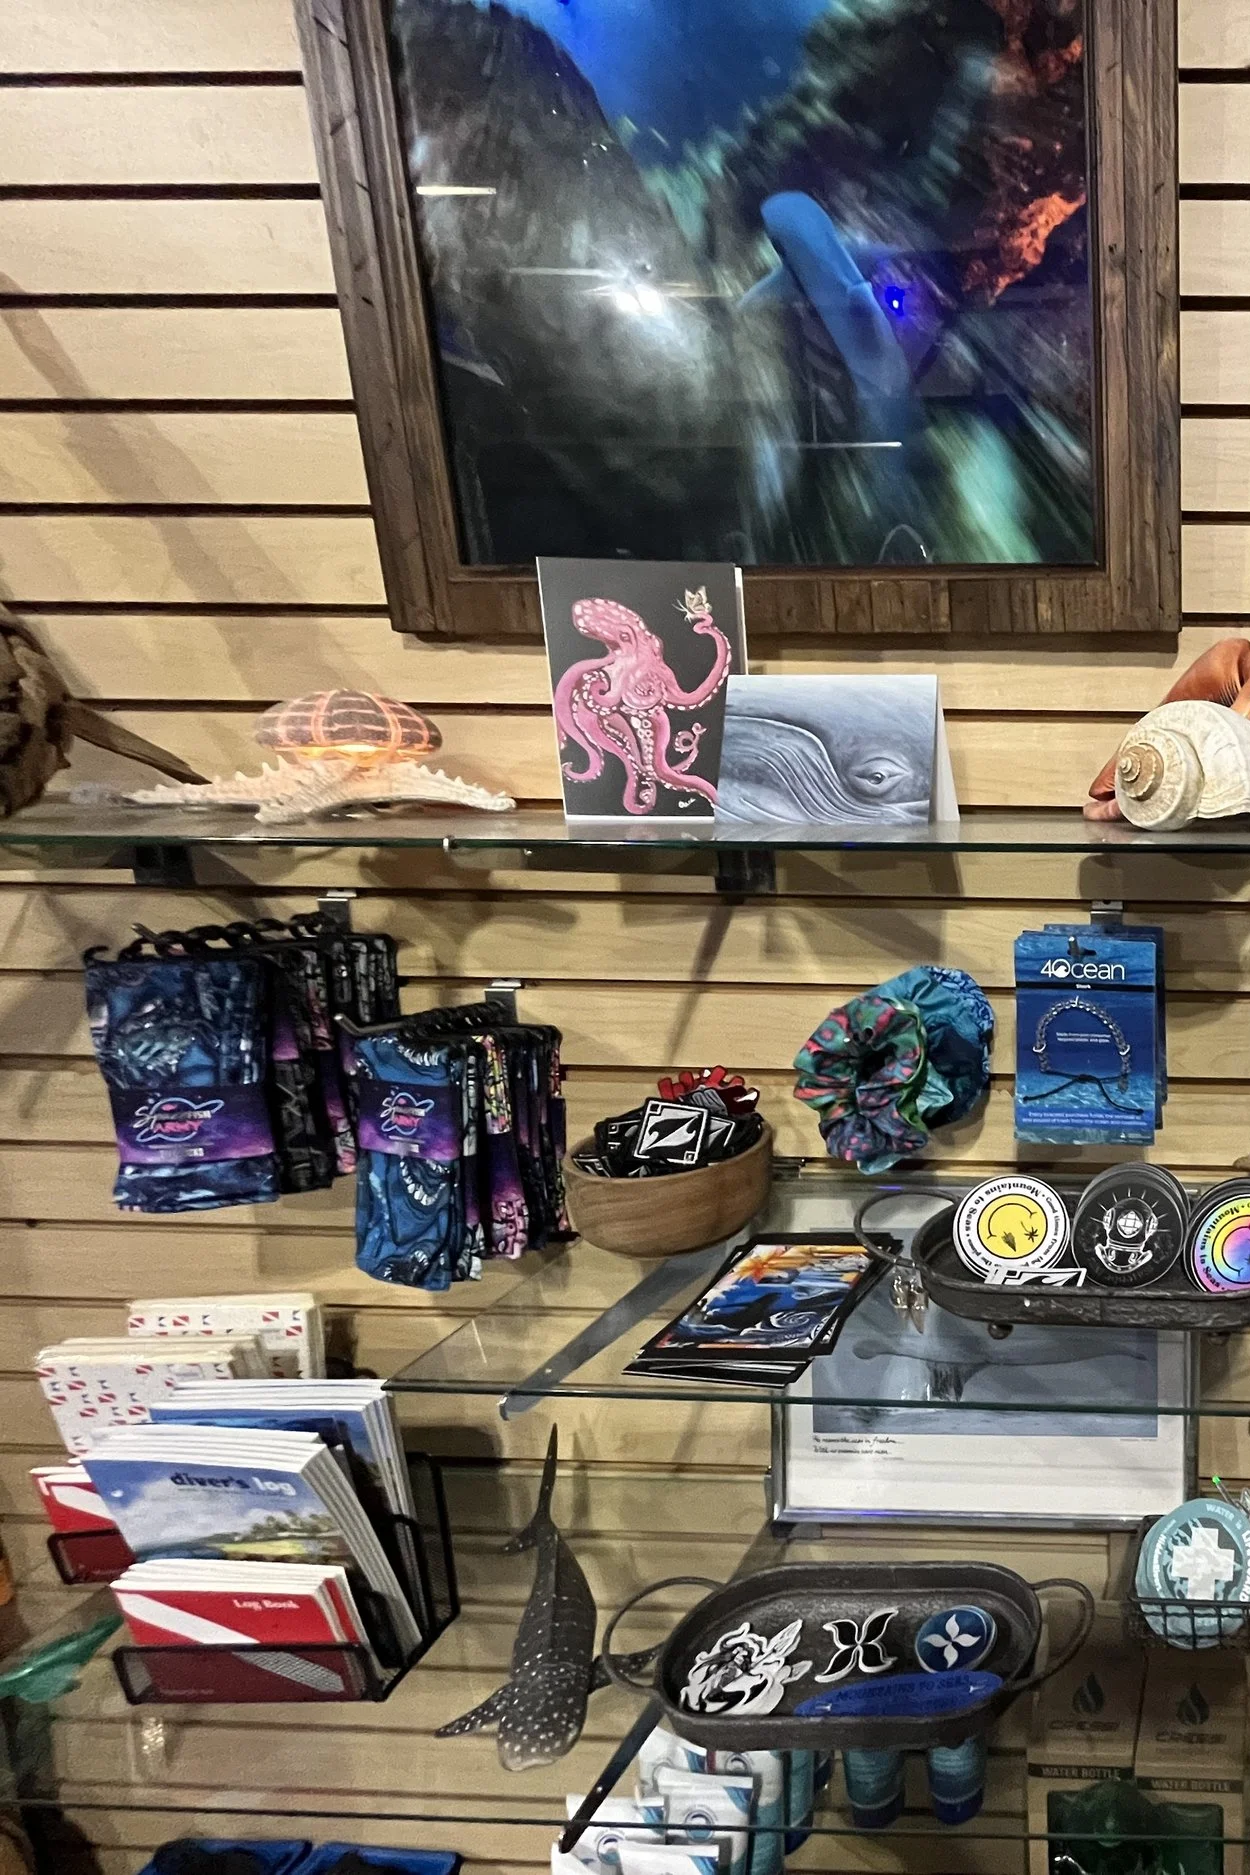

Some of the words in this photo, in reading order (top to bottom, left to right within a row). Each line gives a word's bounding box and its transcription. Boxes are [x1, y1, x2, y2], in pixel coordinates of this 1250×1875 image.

[985, 1182, 1041, 1197] Mountains
[974, 1196, 985, 1205] to
[1045, 1196, 1058, 1214] Good
[965, 1207, 978, 1232] Seas
[1200, 1206, 1240, 1251] Mountains
[1043, 1238, 1058, 1256] from
[1200, 1254, 1207, 1264] to
[1203, 1266, 1220, 1288] Seas
[170, 1472, 251, 1489] diver's
[251, 1476, 297, 1496] log
[1206, 1503, 1234, 1520] WATER
[232, 1599, 262, 1611] Log
[262, 1600, 300, 1609] Book
[1041, 1767, 1078, 1777] WATER
[1081, 1768, 1120, 1779] BOTTLE
[1151, 1779, 1188, 1790] WATER
[1191, 1780, 1231, 1791] BOTTLE
